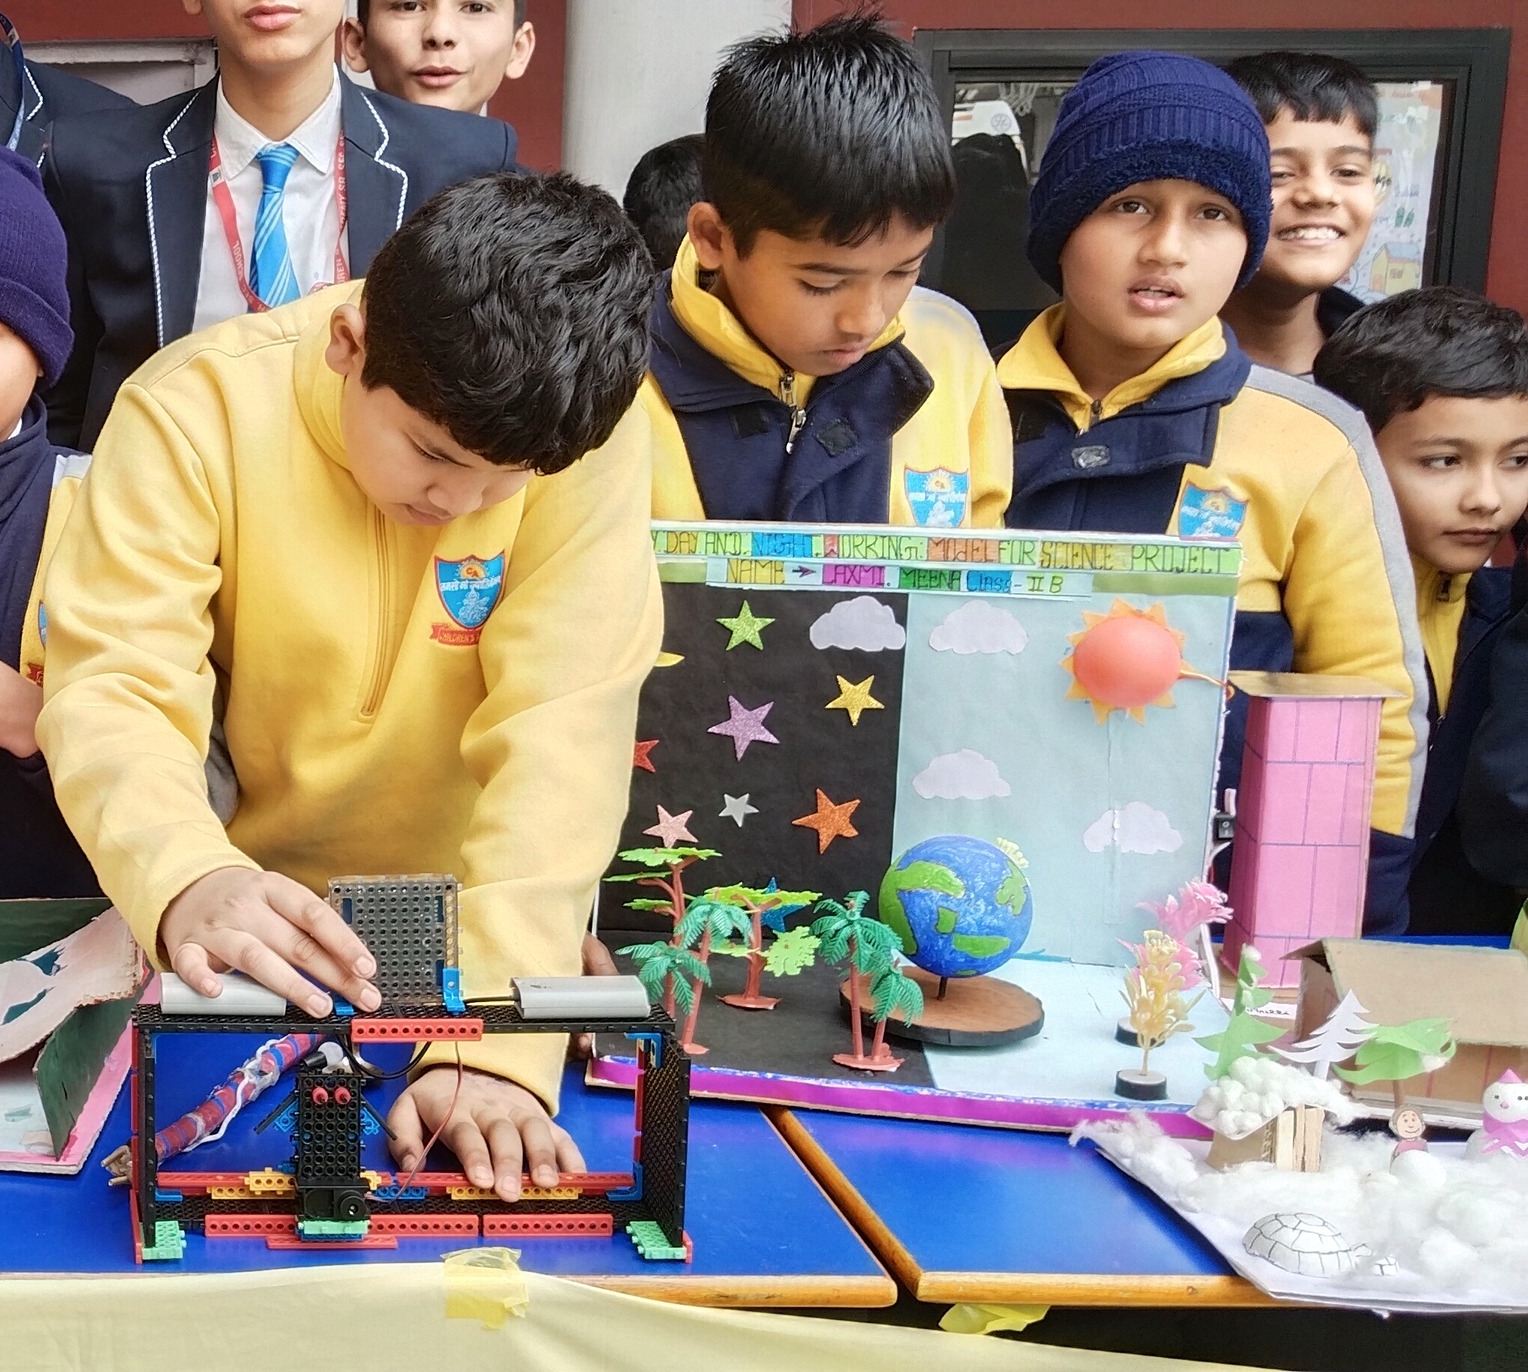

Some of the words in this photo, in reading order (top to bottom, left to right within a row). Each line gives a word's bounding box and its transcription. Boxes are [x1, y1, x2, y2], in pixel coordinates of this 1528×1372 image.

[465, 567, 479, 578] CA
[998, 540, 1035, 565] FOR
[1040, 541, 1114, 570] SCIENCE
[1129, 544, 1232, 574] PROJECT
[728, 558, 785, 584] NAME
[900, 567, 961, 590] MEENA
